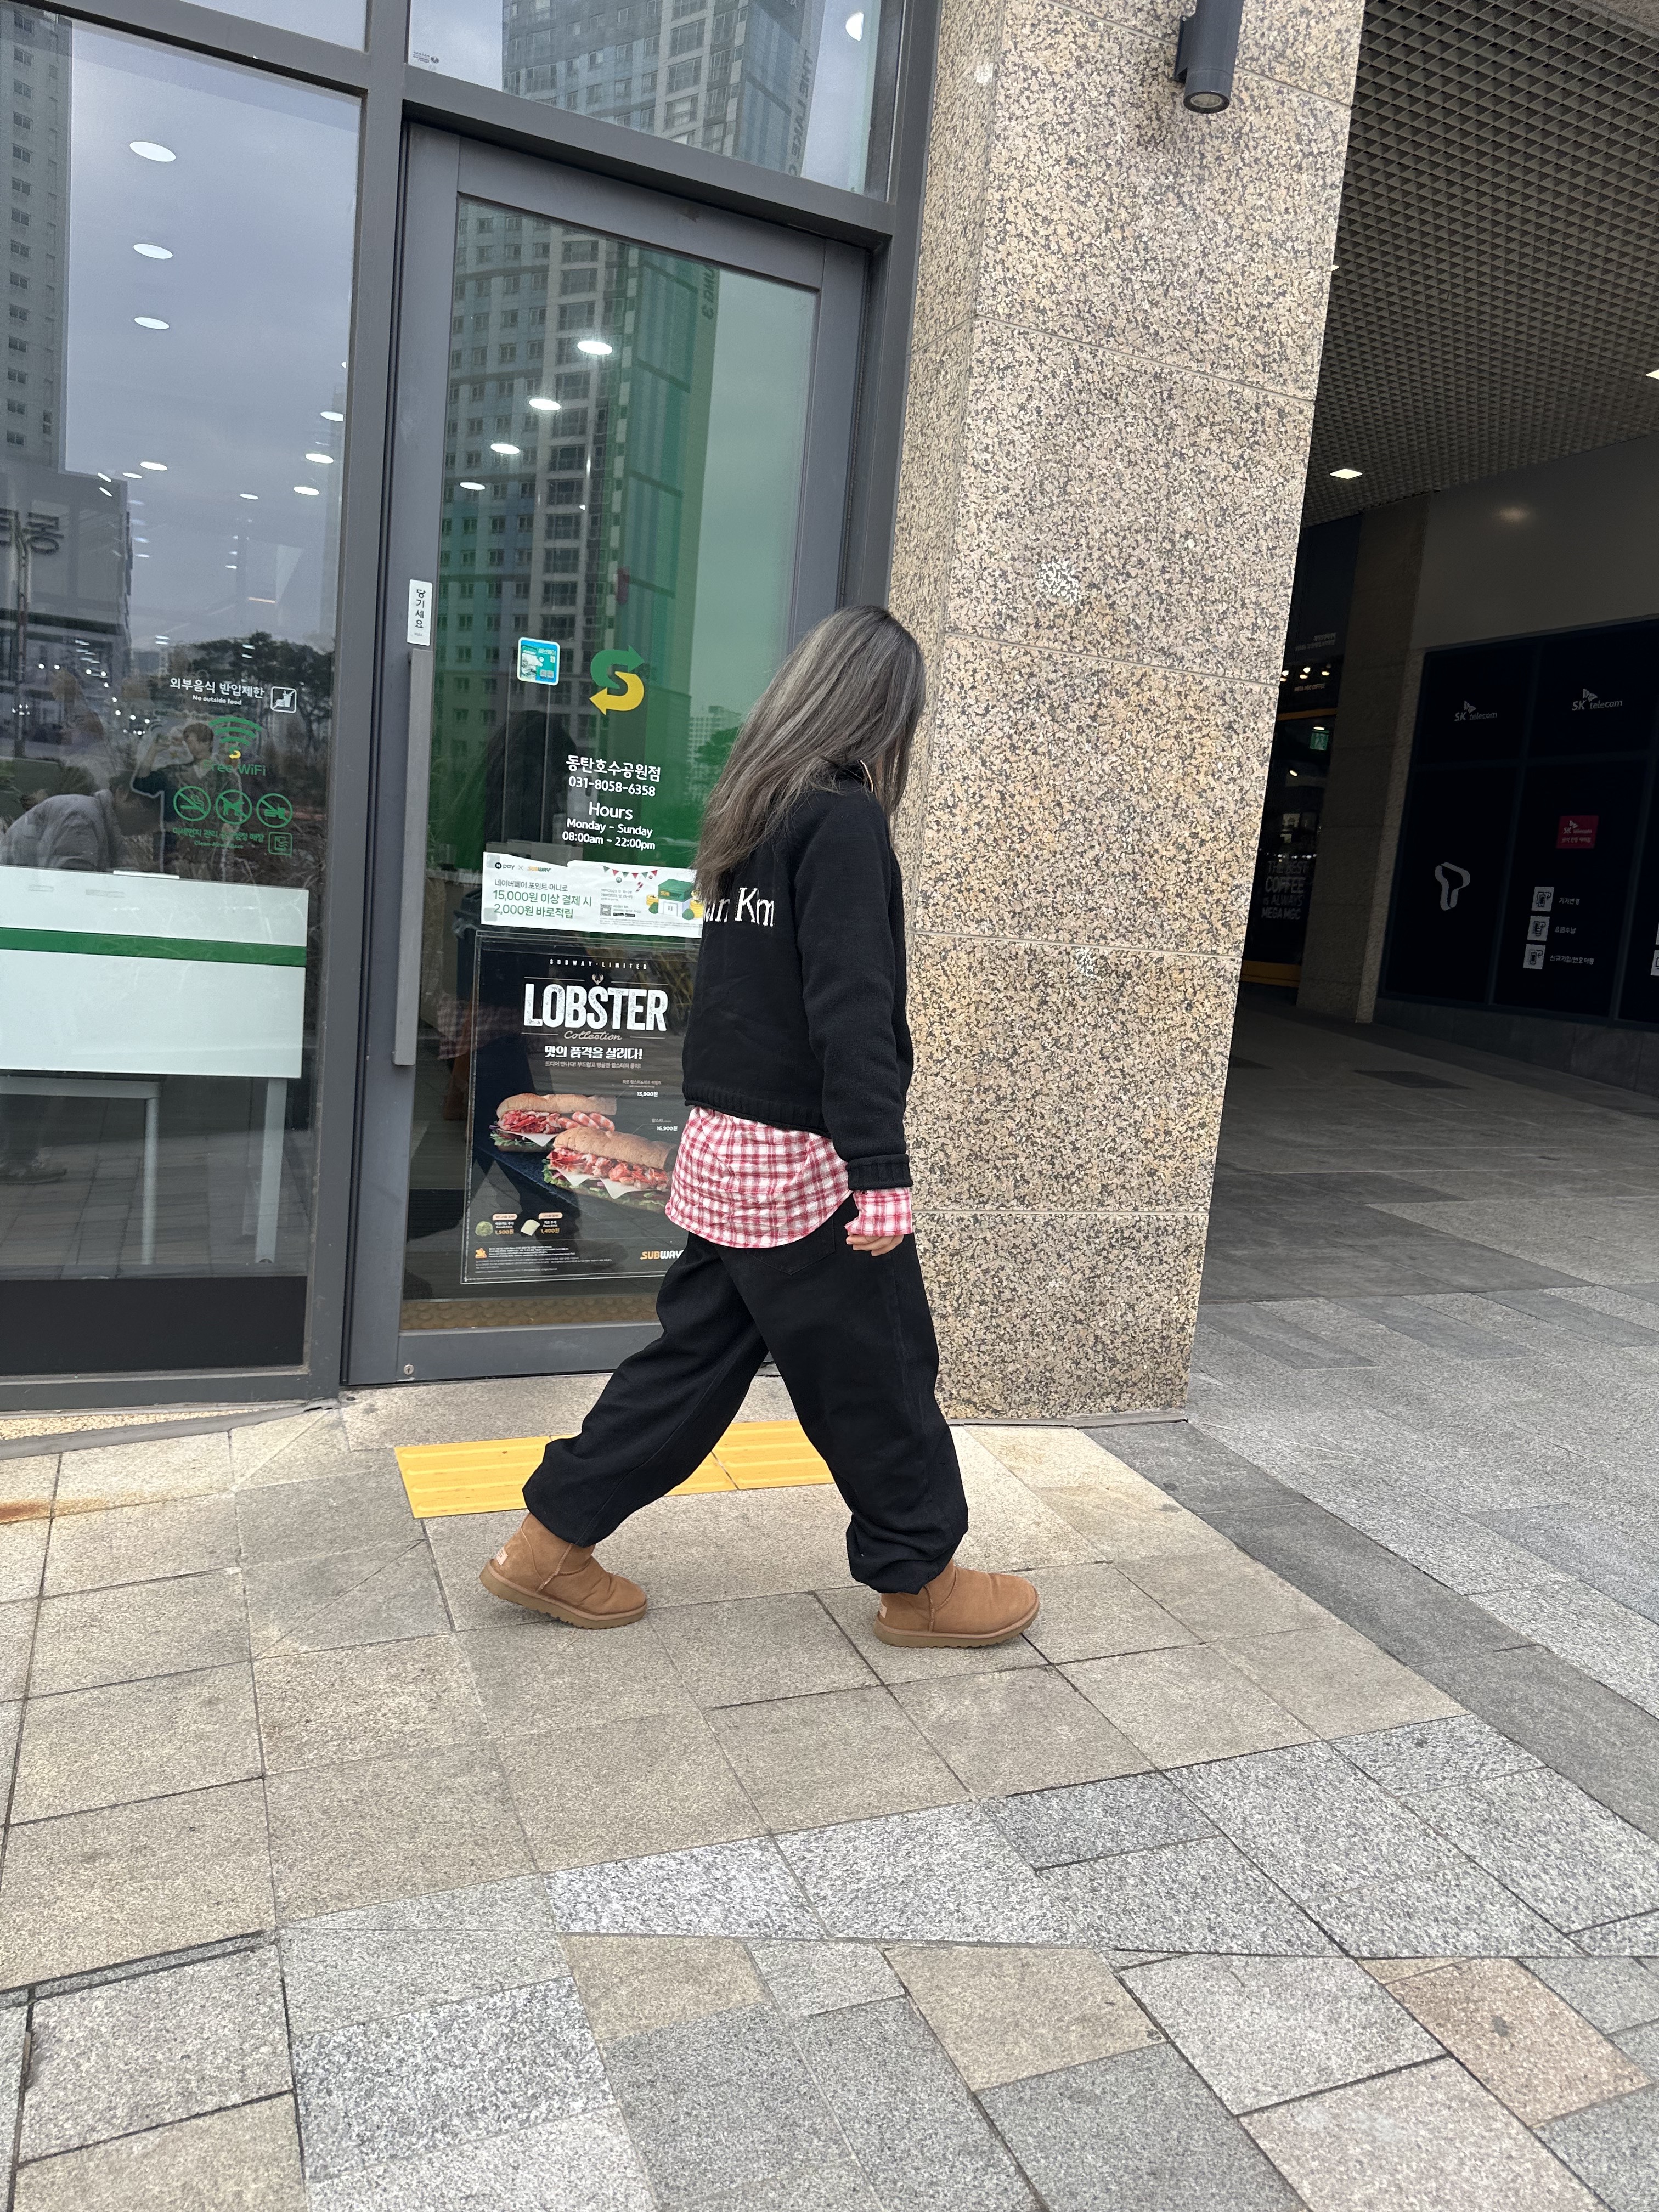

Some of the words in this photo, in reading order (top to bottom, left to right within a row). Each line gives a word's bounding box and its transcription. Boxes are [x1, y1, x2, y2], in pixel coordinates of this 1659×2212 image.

[415, 589, 426, 628] 당기세요
[170, 678, 216, 694] 외부음식
[219, 682, 265, 699] 반입제한
[1572, 700, 1585, 711] SK
[1590, 699, 1622, 709] telecom
[1454, 712, 1466, 721] SK
[1470, 711, 1497, 720] telecom
[238, 764, 266, 776] WiFi
[566, 755, 661, 782] 동탄호수공원점
[568, 776, 656, 797] 031-8058-6358
[589, 802, 633, 820] Hours
[567, 818, 606, 833] Monday
[617, 823, 653, 838] Sunday
[562, 831, 603, 844] 08:00am
[615, 837, 656, 851] 22:00pm
[495, 879, 527, 888] 네이버페이
[1265, 876, 1305, 893] COFFEE
[493, 890, 538, 903] 15,000원
[540, 893, 560, 905] 이상
[562, 895, 580, 906] 결제
[583, 896, 591, 906] 시
[494, 904, 533, 916] 2,000원
[536, 906, 573, 919] 바로적립
[1261, 907, 1282, 919] MEGA
[602, 962, 647, 970] LIMITED
[524, 983, 668, 1031] LOBSTER
[563, 1030, 622, 1041] Collection
[544, 1045, 567, 1058] 맛의
[570, 1046, 603, 1059] 품격을
[605, 1047, 643, 1060] 살리다!
[640, 1250, 684, 1260] SUBWAY
